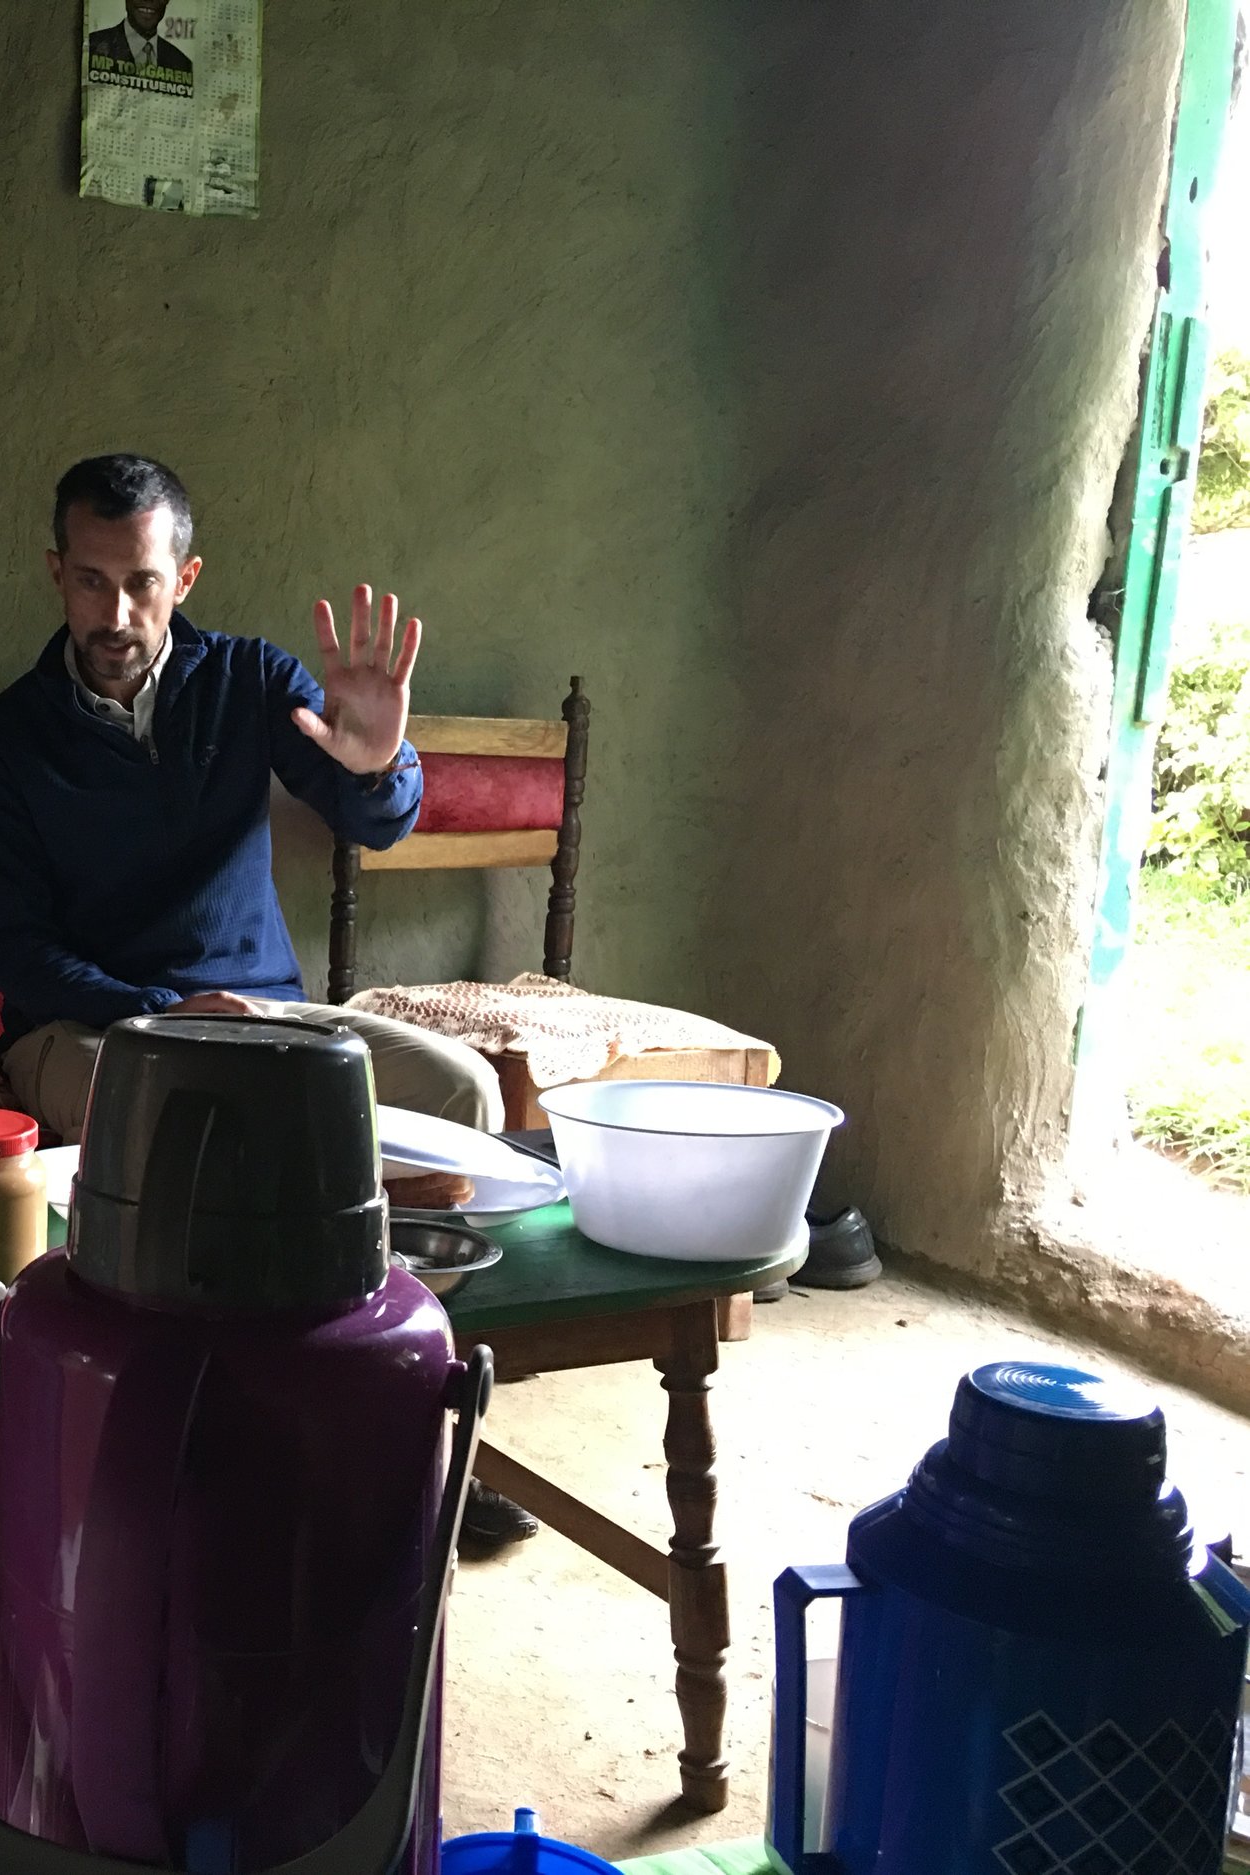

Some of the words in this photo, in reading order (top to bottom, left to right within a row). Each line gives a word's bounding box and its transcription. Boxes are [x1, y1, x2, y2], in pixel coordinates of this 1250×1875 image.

[165, 17, 197, 39] 2017
[92, 55, 114, 69] MP
[117, 60, 192, 84] TONGAREN
[90, 70, 193, 96] CONSTITUENCY
